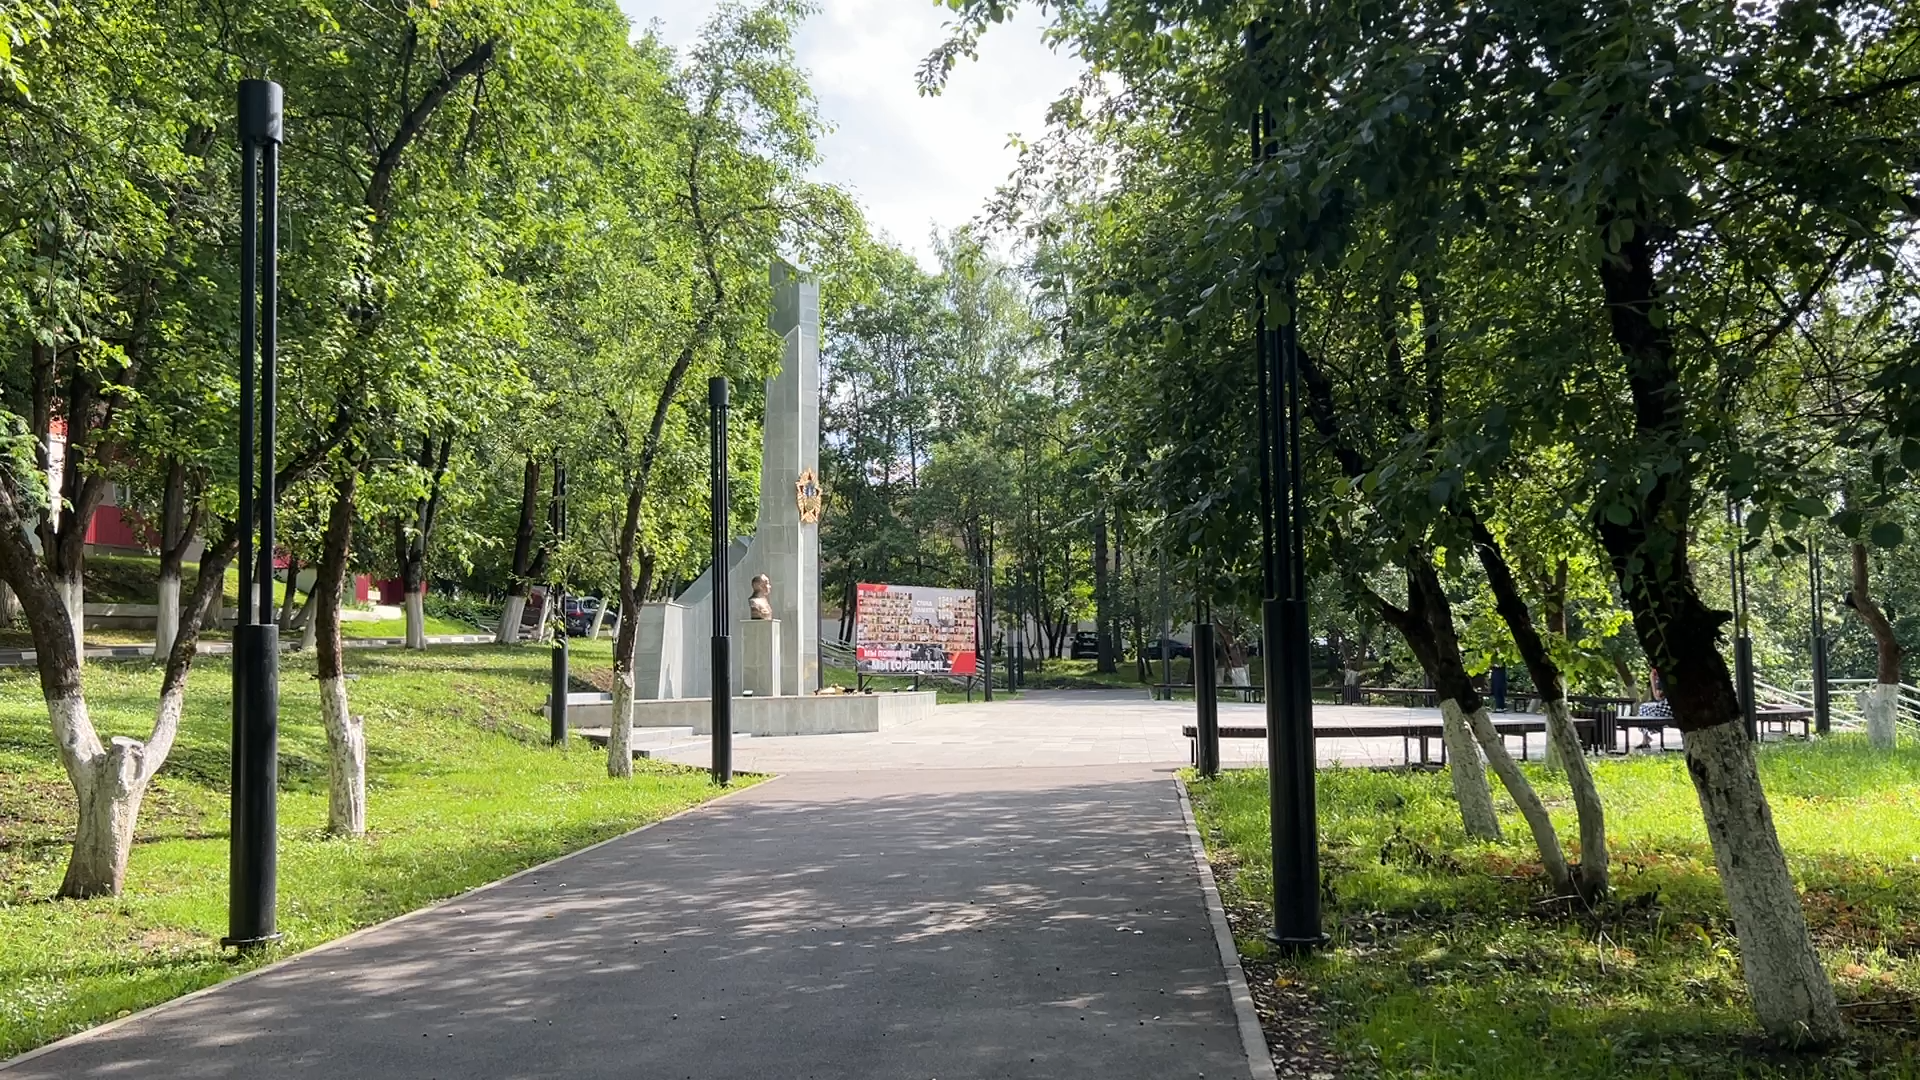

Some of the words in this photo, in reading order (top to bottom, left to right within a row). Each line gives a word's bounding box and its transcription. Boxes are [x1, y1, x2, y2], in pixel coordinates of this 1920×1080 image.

[864, 649, 877, 657] МЫ
[871, 660, 888, 670] МЫ
[889, 660, 943, 671] ГОРДИМСЯ!
